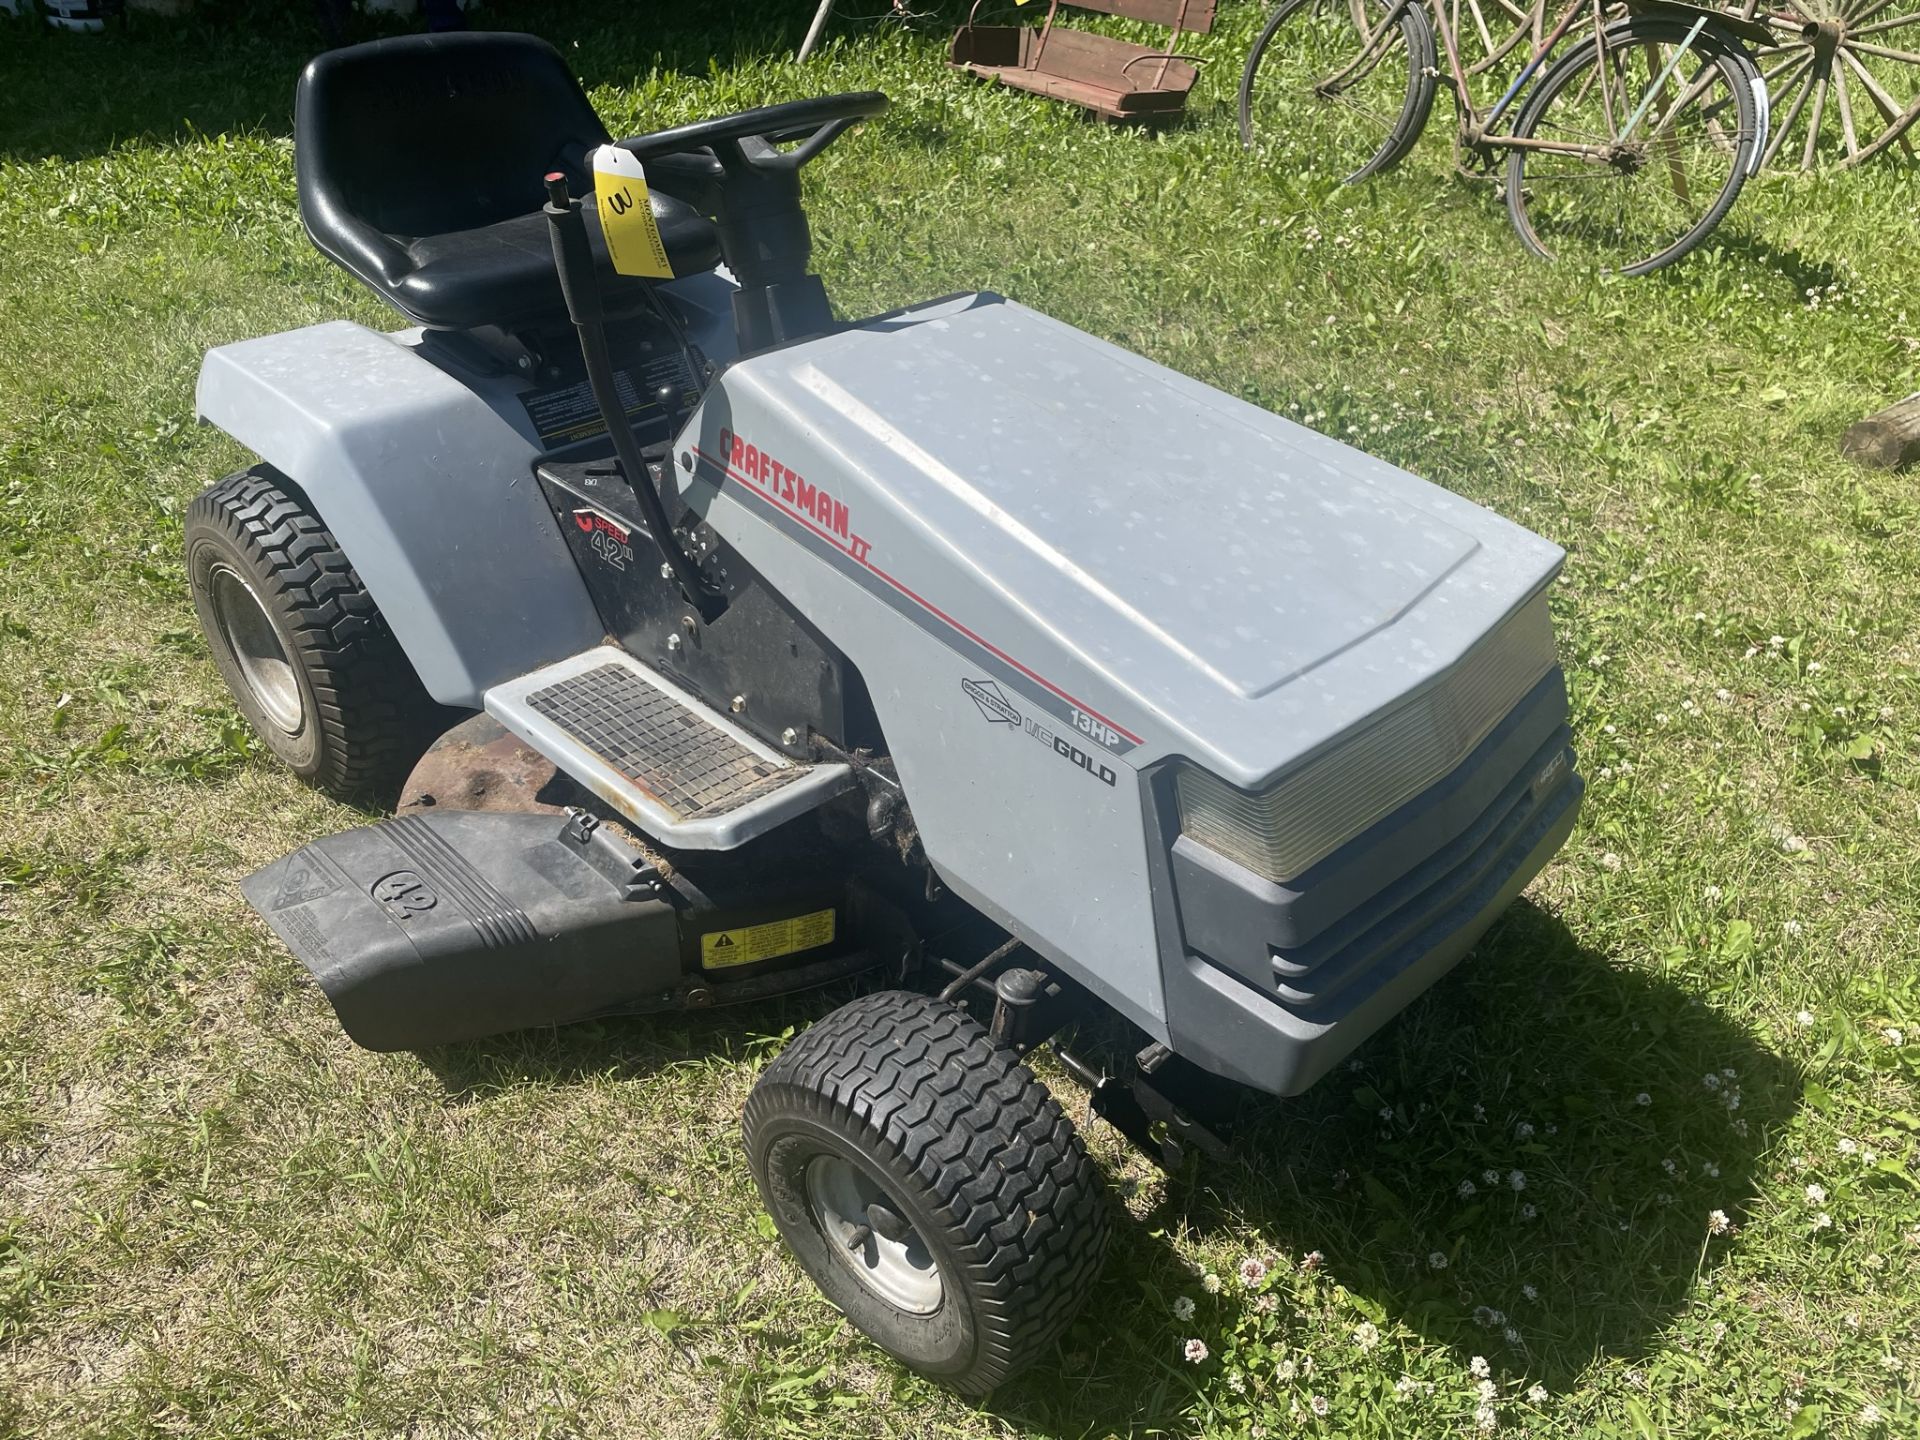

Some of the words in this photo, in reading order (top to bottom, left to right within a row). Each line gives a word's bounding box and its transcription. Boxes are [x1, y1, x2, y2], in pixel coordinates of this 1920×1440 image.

[607, 186, 632, 216] 3
[643, 198, 669, 269] MONTGOMERY
[719, 427, 849, 539] CRAFTSMAN
[847, 533, 872, 566] II
[594, 516, 629, 545] SPEED
[964, 682, 985, 700] BRIGGS
[989, 700, 1019, 723] STRATTON
[1071, 709, 1120, 747] 13HP
[384, 882, 437, 920] 42
